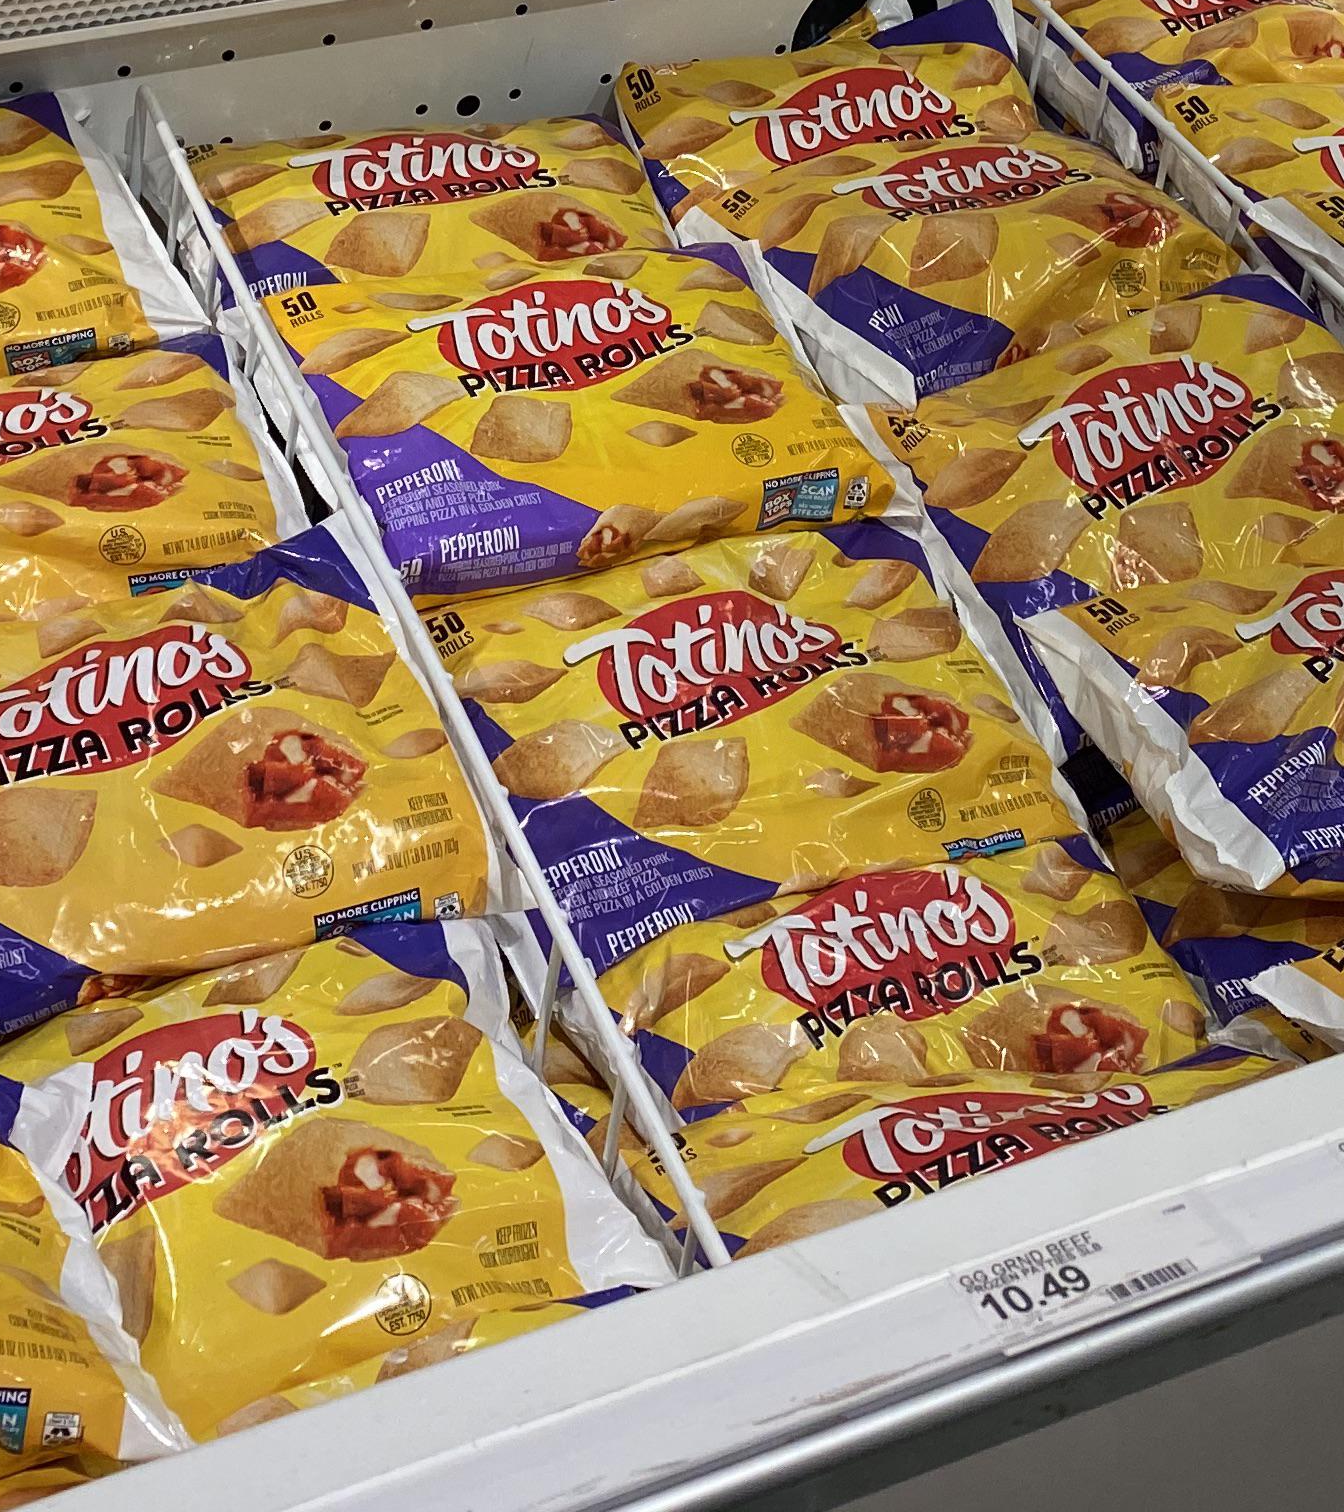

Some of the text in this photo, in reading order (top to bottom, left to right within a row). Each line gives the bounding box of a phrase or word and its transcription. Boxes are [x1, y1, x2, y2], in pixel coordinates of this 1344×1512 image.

[1160, 4, 1244, 38] PIZZA
[625, 67, 656, 99] 50
[634, 90, 661, 112] ROLLS
[730, 72, 952, 162] Totino's
[1174, 95, 1212, 125] 50
[1188, 112, 1220, 135] ROLLS
[288, 136, 537, 198] Totino's
[833, 145, 1066, 204] Totino's
[324, 168, 557, 218] PIZZA ROLLS
[721, 188, 751, 215] 50
[280, 290, 317, 318] 50
[288, 308, 324, 329] ROLLS
[51, 329, 94, 345] CLIPPING
[407, 282, 670, 363] Totino's
[458, 324, 694, 399] PIZZA ROLLS
[1018, 354, 1252, 485] Totino's
[1081, 393, 1282, 522] PIZZA ROLLS
[375, 459, 462, 505] PEPPERONI
[765, 479, 779, 489] NO
[800, 485, 835, 496] SCAN
[384, 490, 495, 522] CHICKEN AND BEEF PIZZA
[388, 491, 542, 533] TOPPING PIZZA GOLDEN CRUST
[764, 491, 791, 511] BOX
[766, 499, 794, 518] TOPS
[439, 524, 521, 564] PEPPERONI
[130, 570, 179, 585] NO MORE
[425, 610, 467, 645] 50
[1088, 597, 1129, 624] 50
[1104, 609, 1141, 636] ROLLS
[437, 628, 476, 662] ROLLS
[563, 599, 835, 716] Totino's
[120, 677, 275, 754] ROLLS
[618, 684, 749, 753] PIZZA
[1247, 740, 1328, 805] PEPPERONI
[592, 861, 644, 890] SEASONED
[594, 865, 714, 916] PIZZA GOLDEN CRUST
[316, 889, 420, 927] NO MORE CLIPPING
[605, 901, 695, 957] PEPPERONI
[723, 865, 1012, 1004] Totino's
[1045, 1229, 1093, 1256] BEEF
[980, 1264, 1092, 1321] 10.49
[389, 1316, 408, 1333] EST.
